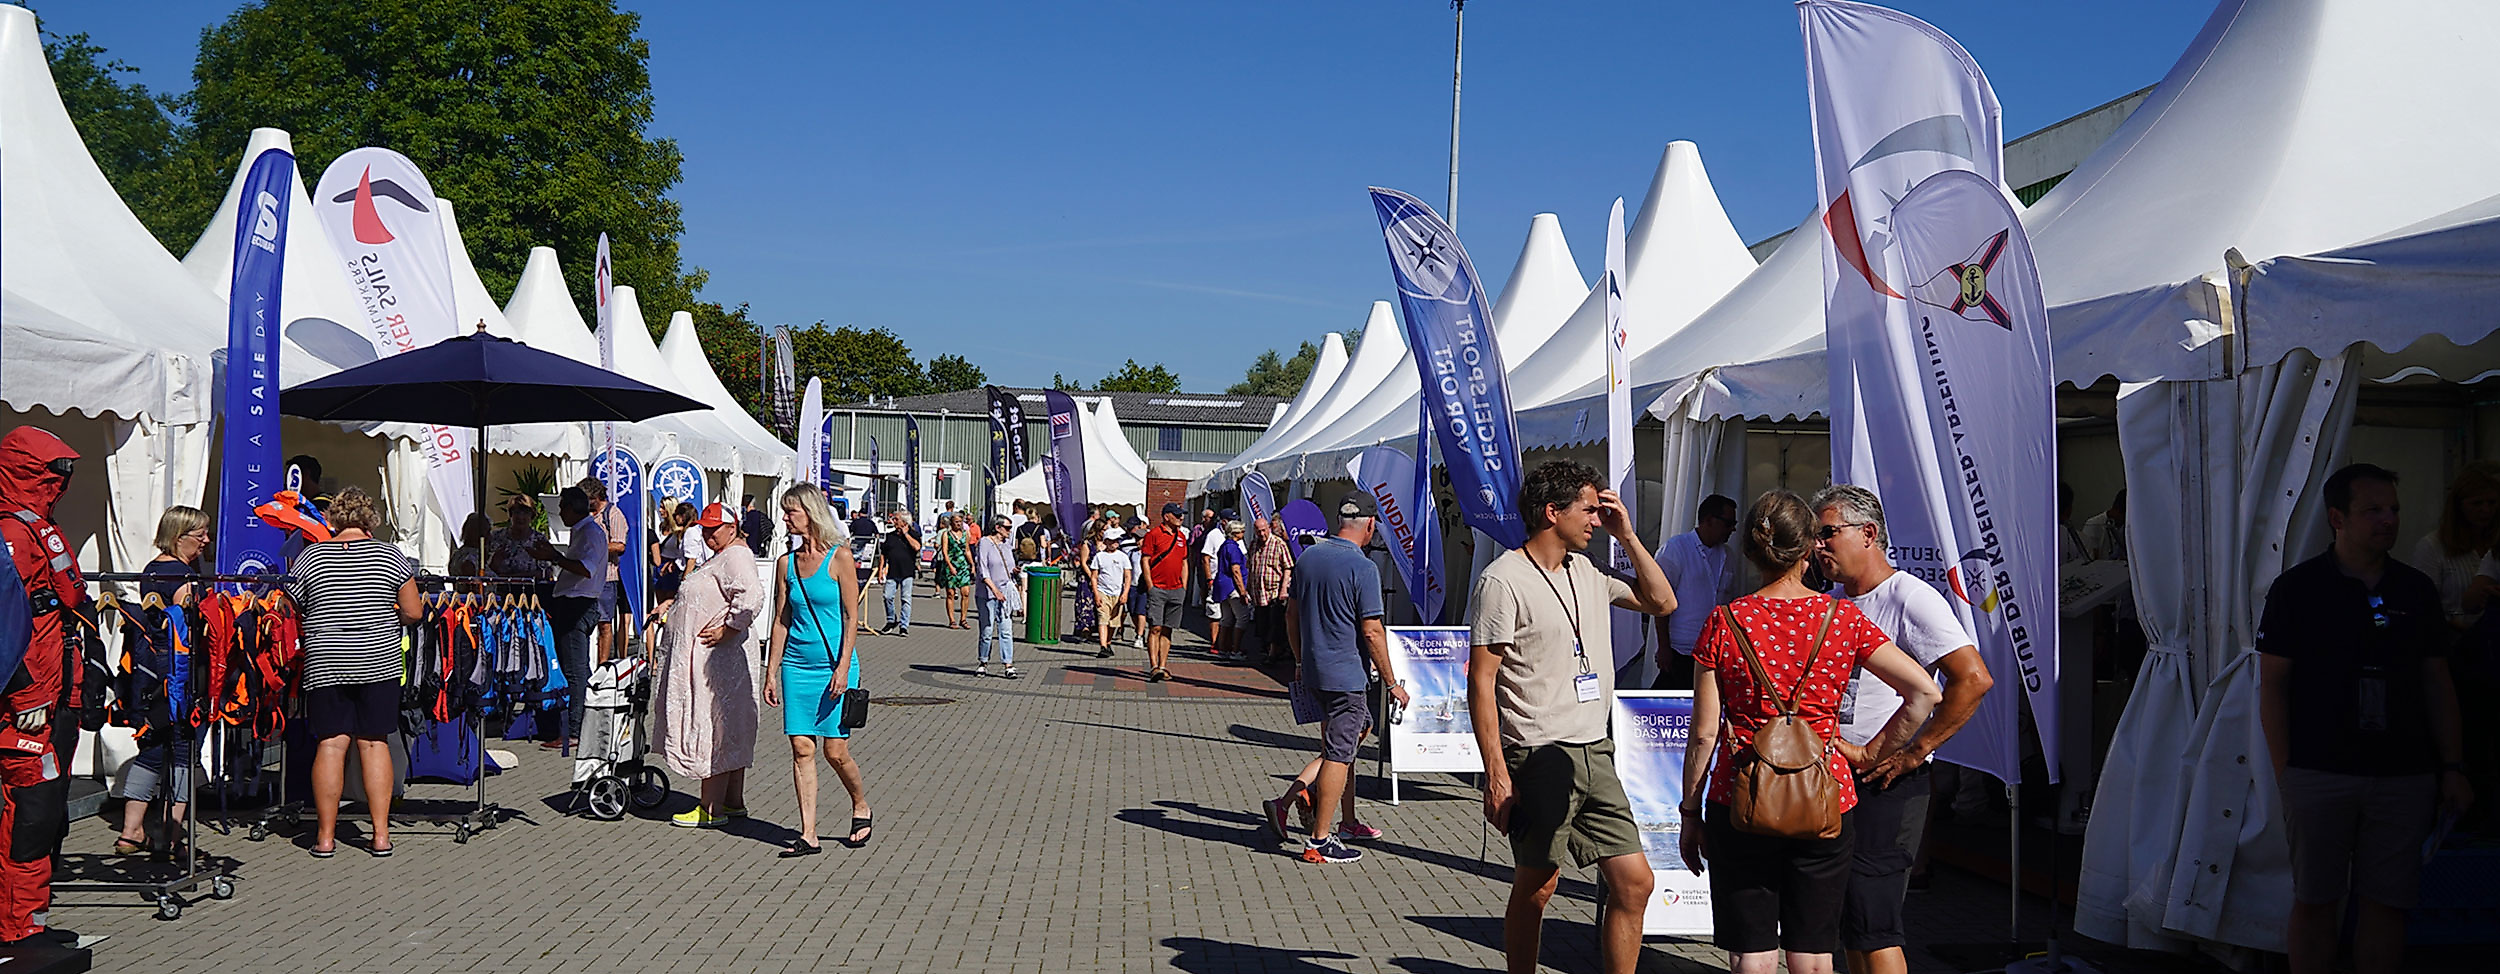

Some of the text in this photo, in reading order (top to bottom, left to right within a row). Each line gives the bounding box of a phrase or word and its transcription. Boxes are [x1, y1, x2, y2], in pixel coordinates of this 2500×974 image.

[246, 292, 265, 528] HAVE A SAFE DAY
[1633, 713, 1691, 727] SPÜRE DE
[1634, 728, 1689, 739] DAS WAS
